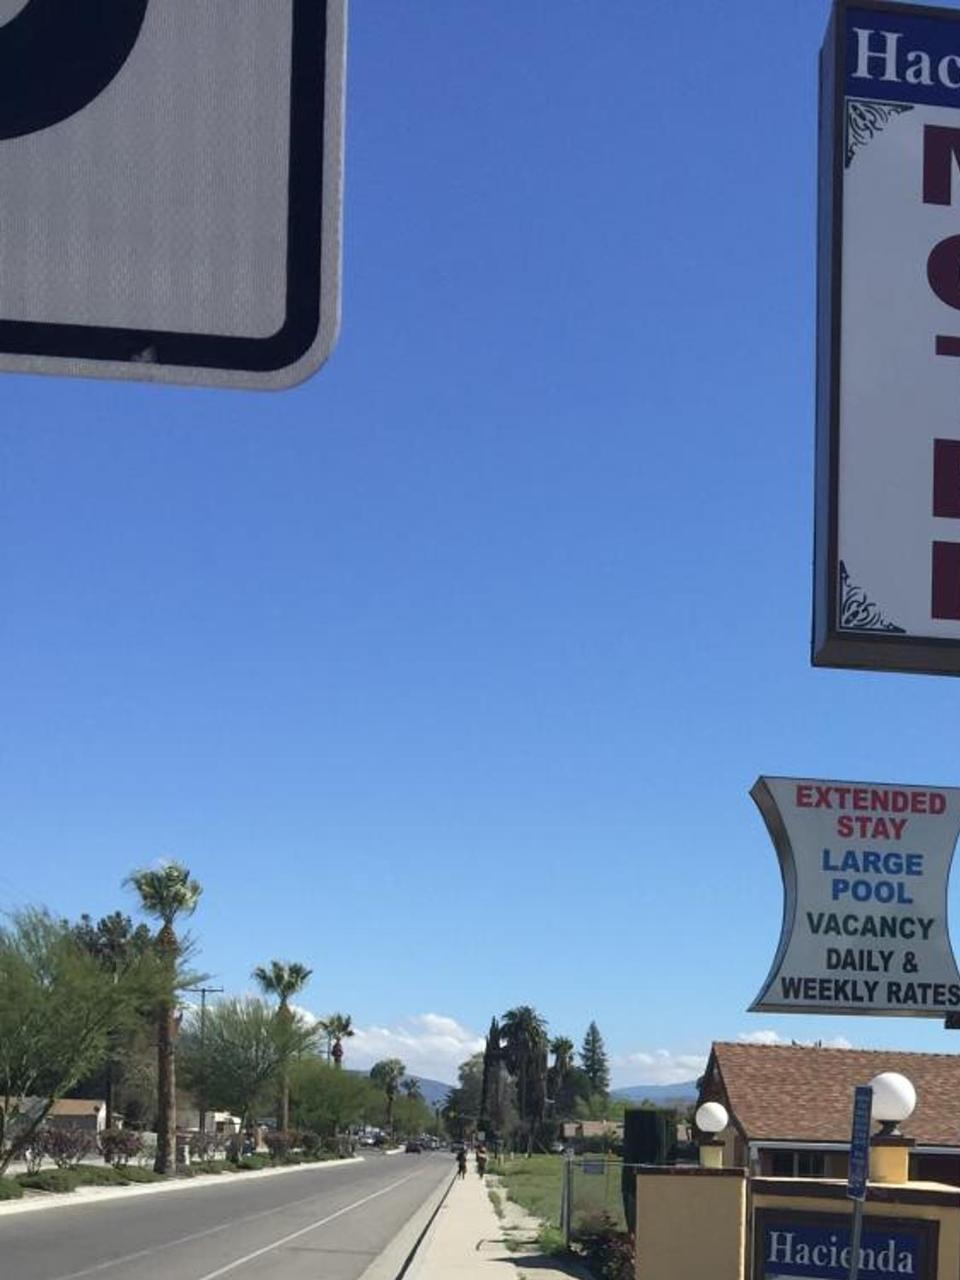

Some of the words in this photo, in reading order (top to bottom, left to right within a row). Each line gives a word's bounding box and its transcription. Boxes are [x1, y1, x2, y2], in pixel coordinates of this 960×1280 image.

[796, 785, 946, 814] EXTENDED
[837, 815, 908, 840] STAY
[822, 849, 923, 876] LARGE
[832, 878, 913, 904] POOL
[806, 912, 934, 940] VACANCY
[826, 948, 894, 972] DAILY
[902, 951, 918, 973] &
[781, 977, 879, 1002] WEEKLY
[887, 982, 960, 1006] RATES
